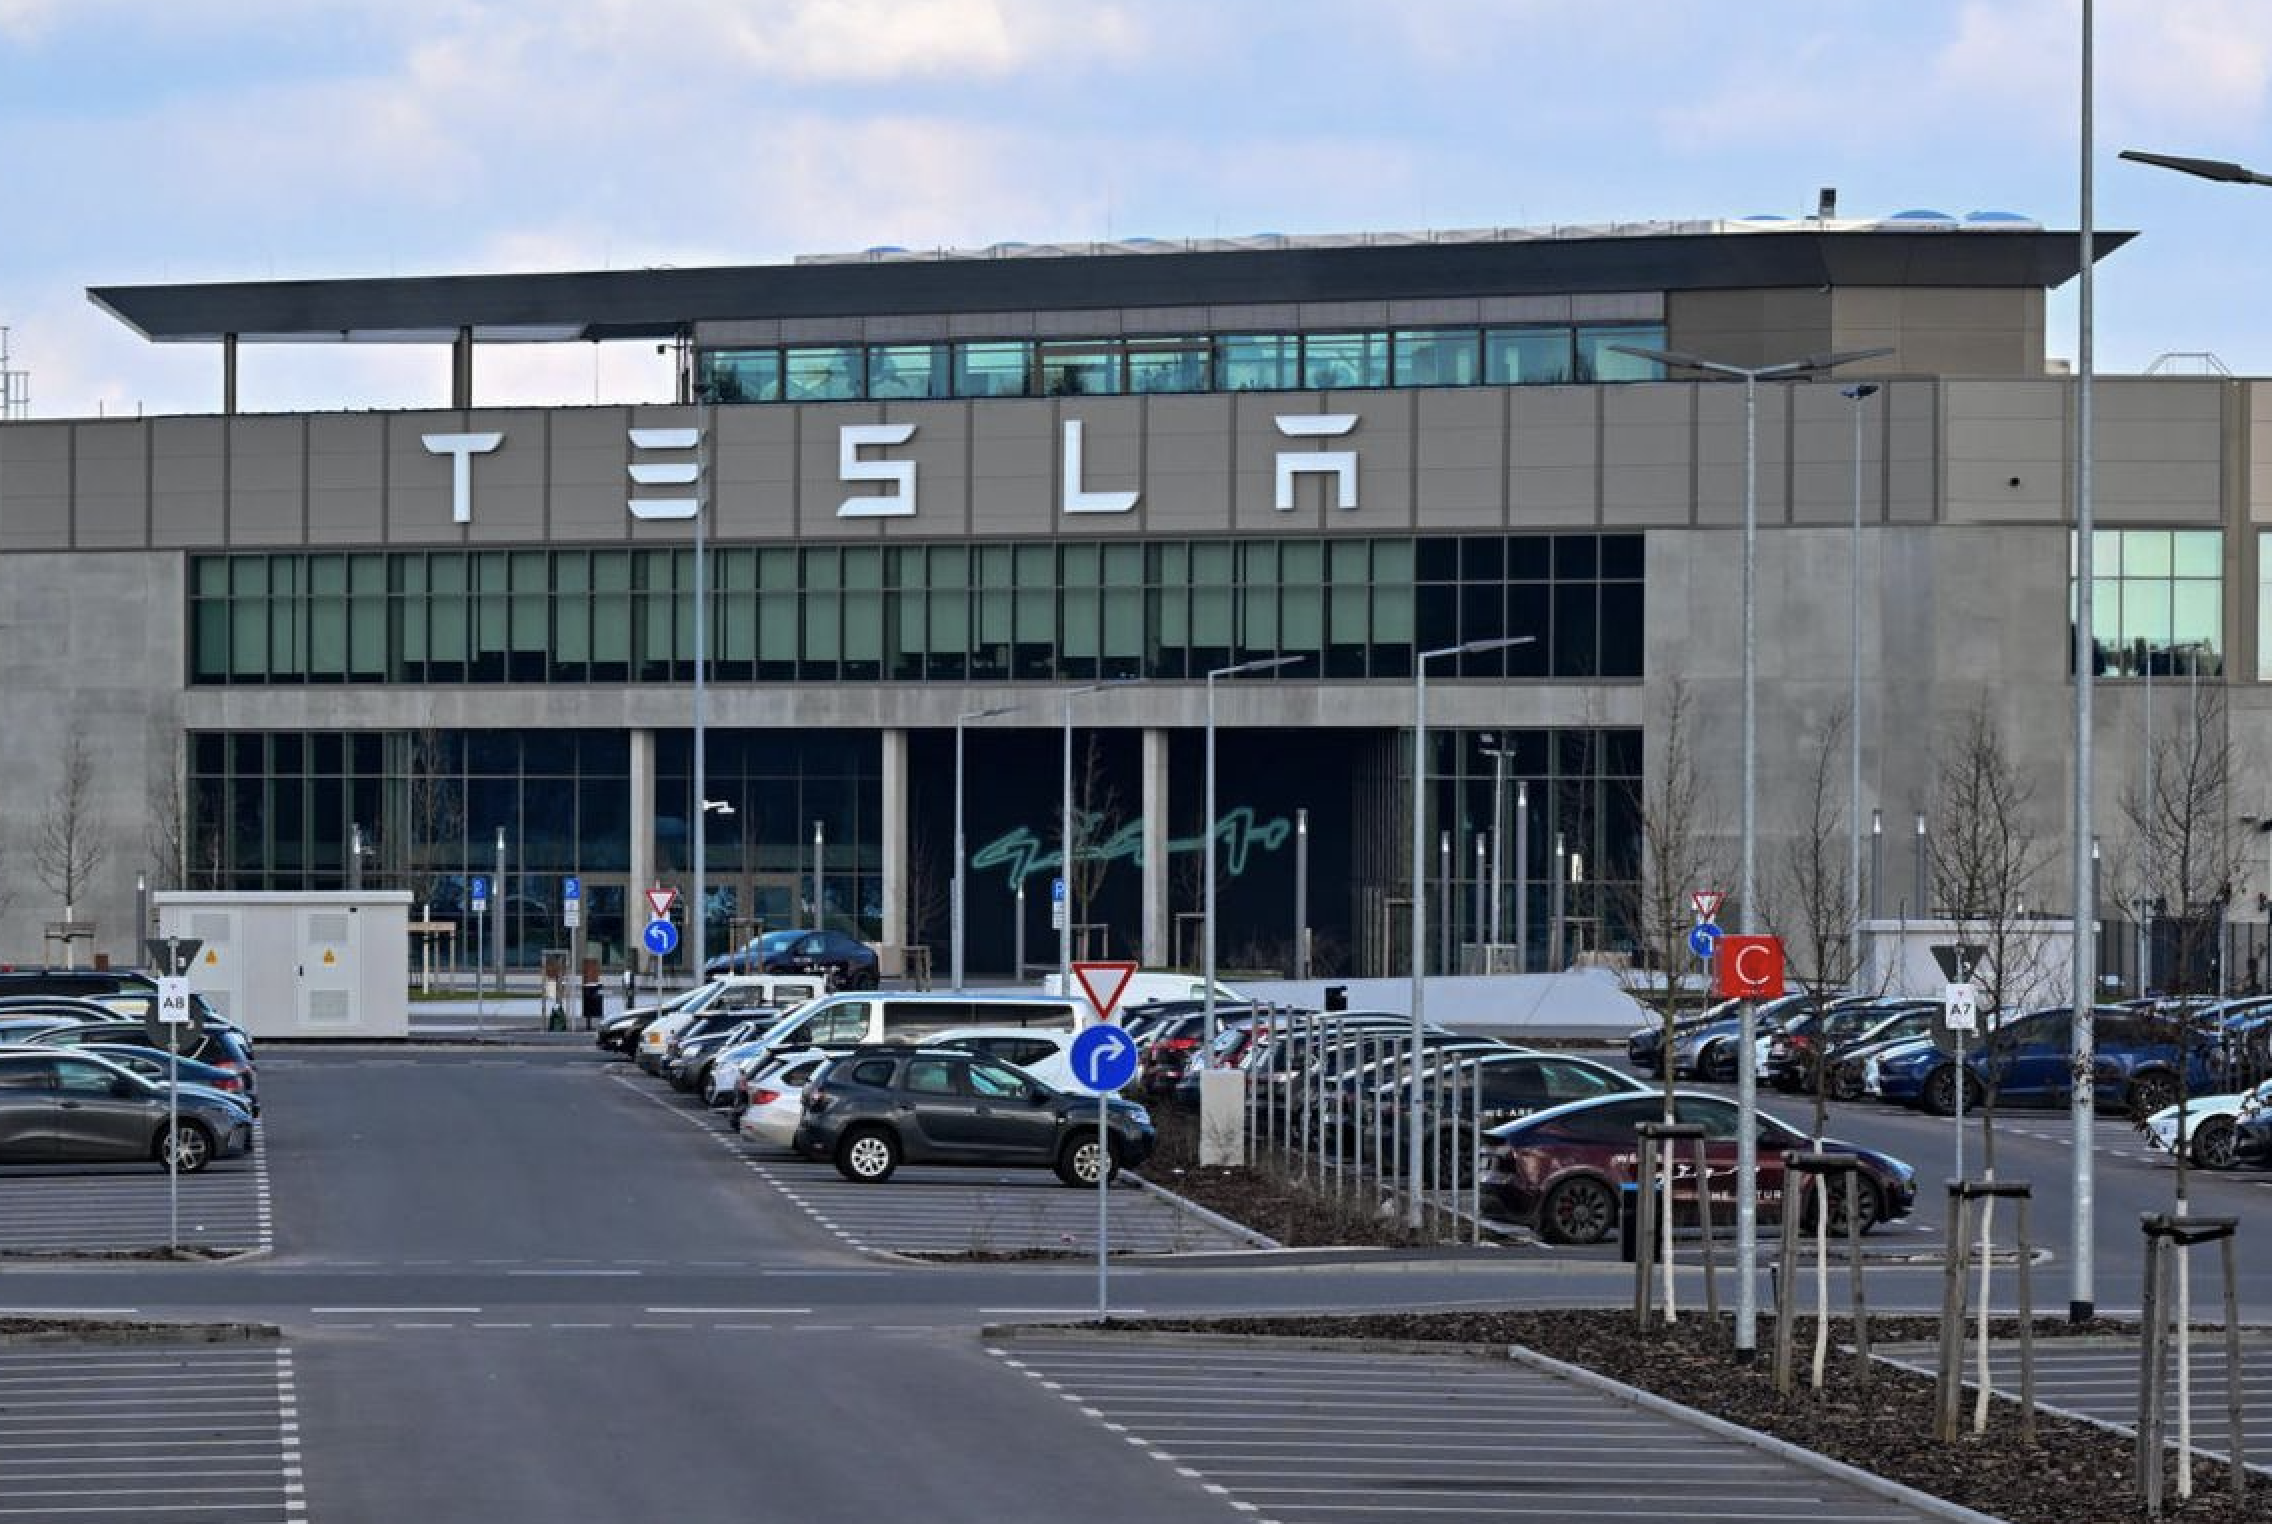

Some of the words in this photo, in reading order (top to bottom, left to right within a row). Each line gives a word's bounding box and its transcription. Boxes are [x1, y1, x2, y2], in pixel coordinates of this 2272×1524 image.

[421, 414, 1359, 523] TESLA
[1736, 944, 1770, 985] C
[1950, 1003, 1971, 1015] A7
